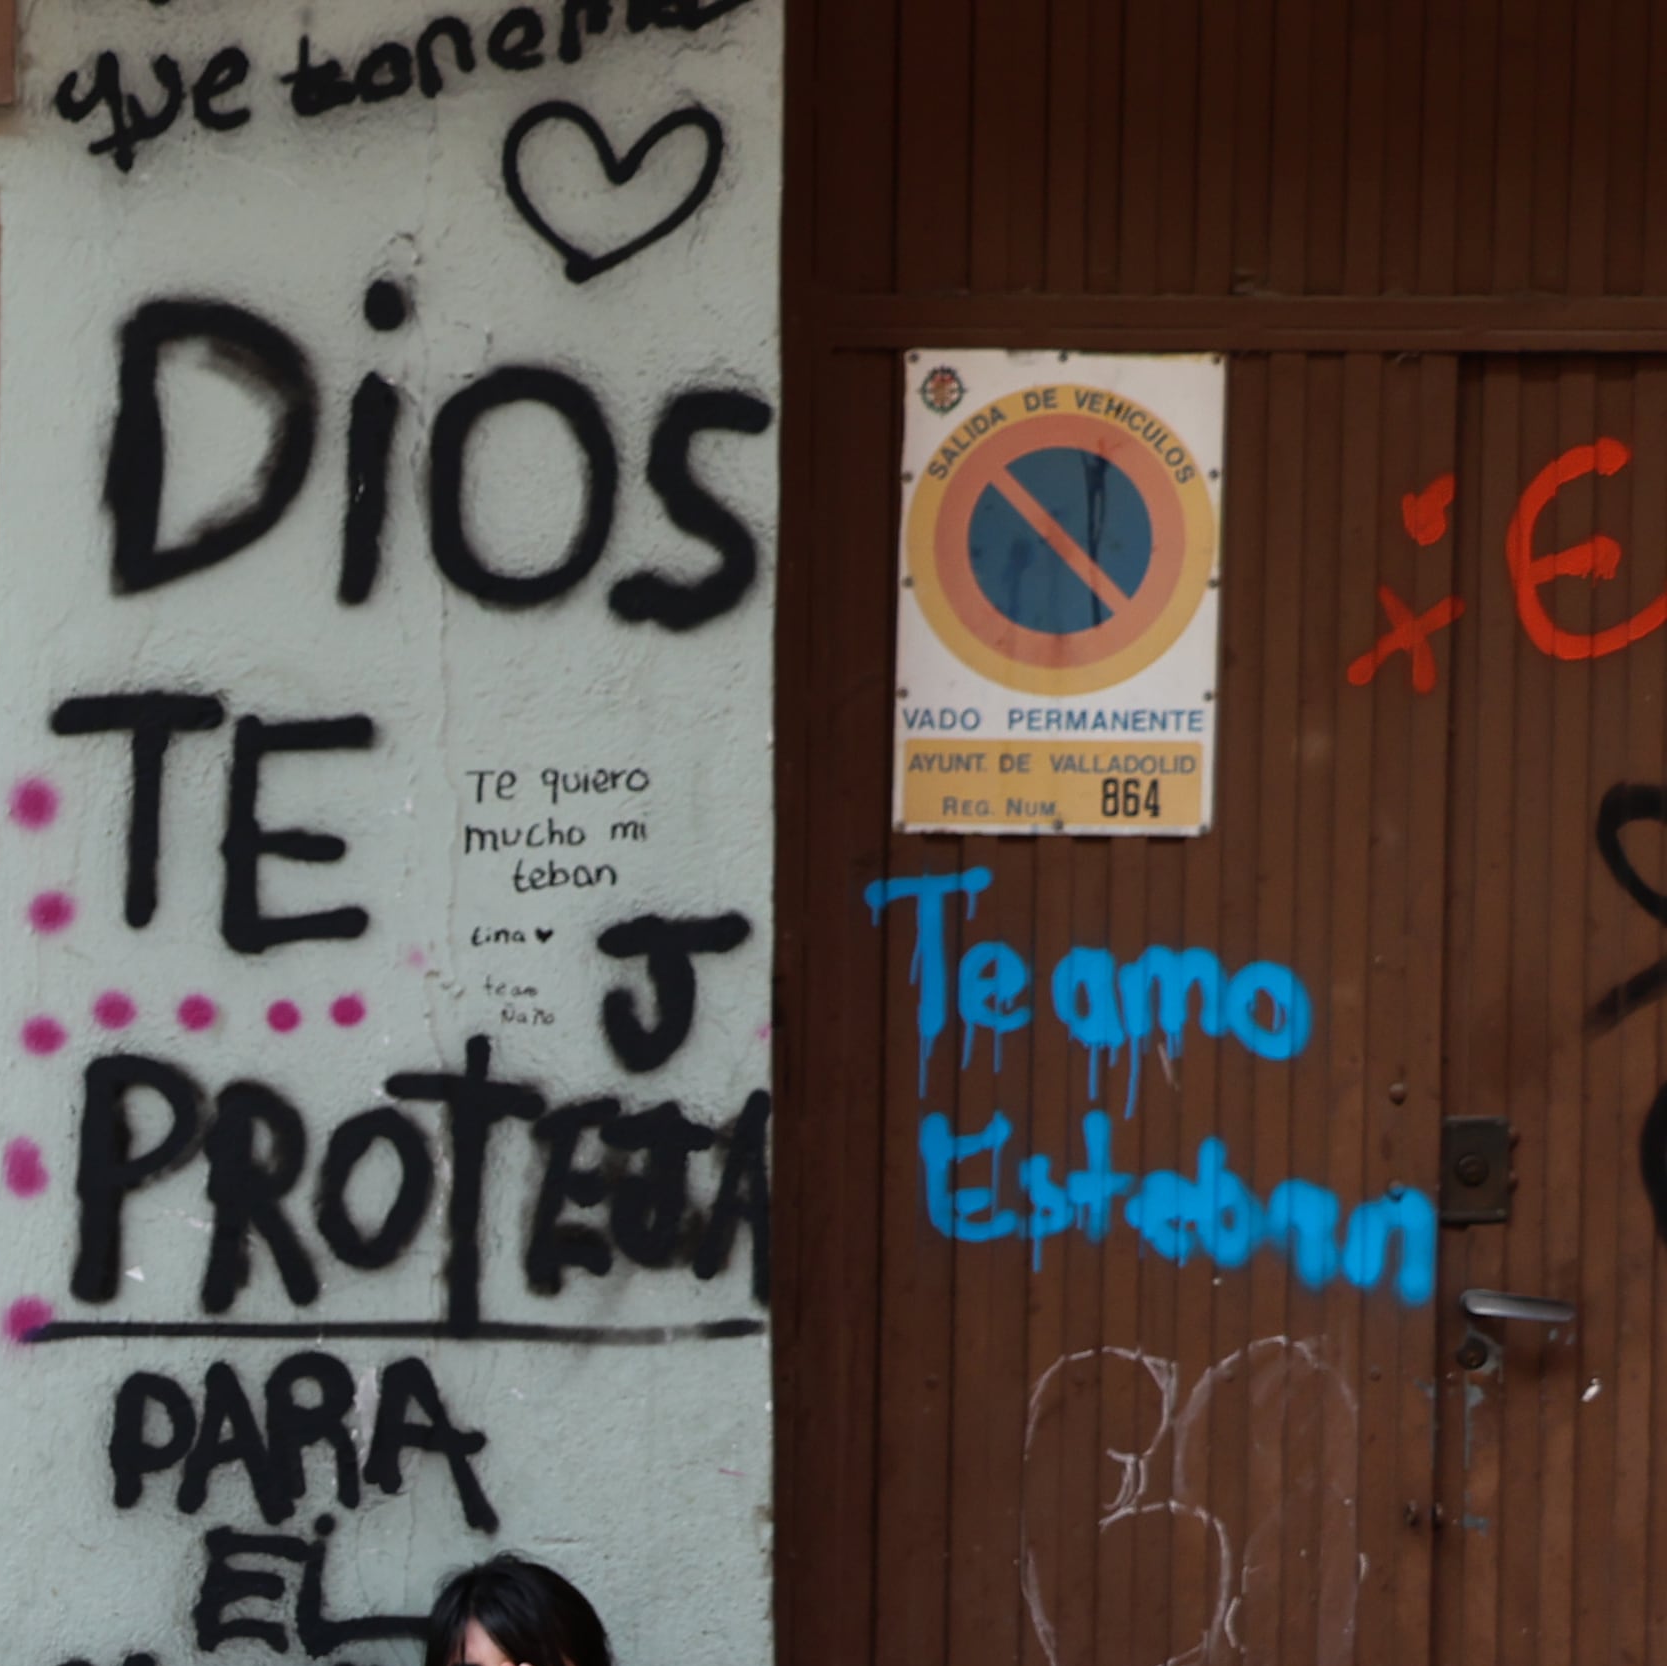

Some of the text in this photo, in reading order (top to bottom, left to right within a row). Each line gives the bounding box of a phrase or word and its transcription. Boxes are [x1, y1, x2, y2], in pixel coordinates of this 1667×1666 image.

[55, 48, 253, 172] que
[926, 387, 1197, 485] SALIDA DE VEHICULOS
[902, 707, 1205, 733] VADO PERMANENTE
[464, 764, 652, 805] Te quiero
[998, 753, 1032, 773] DE
[1048, 754, 1197, 775] VALLADOLID
[1101, 777, 1161, 818] 864
[49, 690, 375, 955] TE
[463, 811, 649, 855] mucho mi
[512, 857, 619, 894] teban
[597, 910, 751, 1074] J
[110, 1350, 499, 1533] PARA
